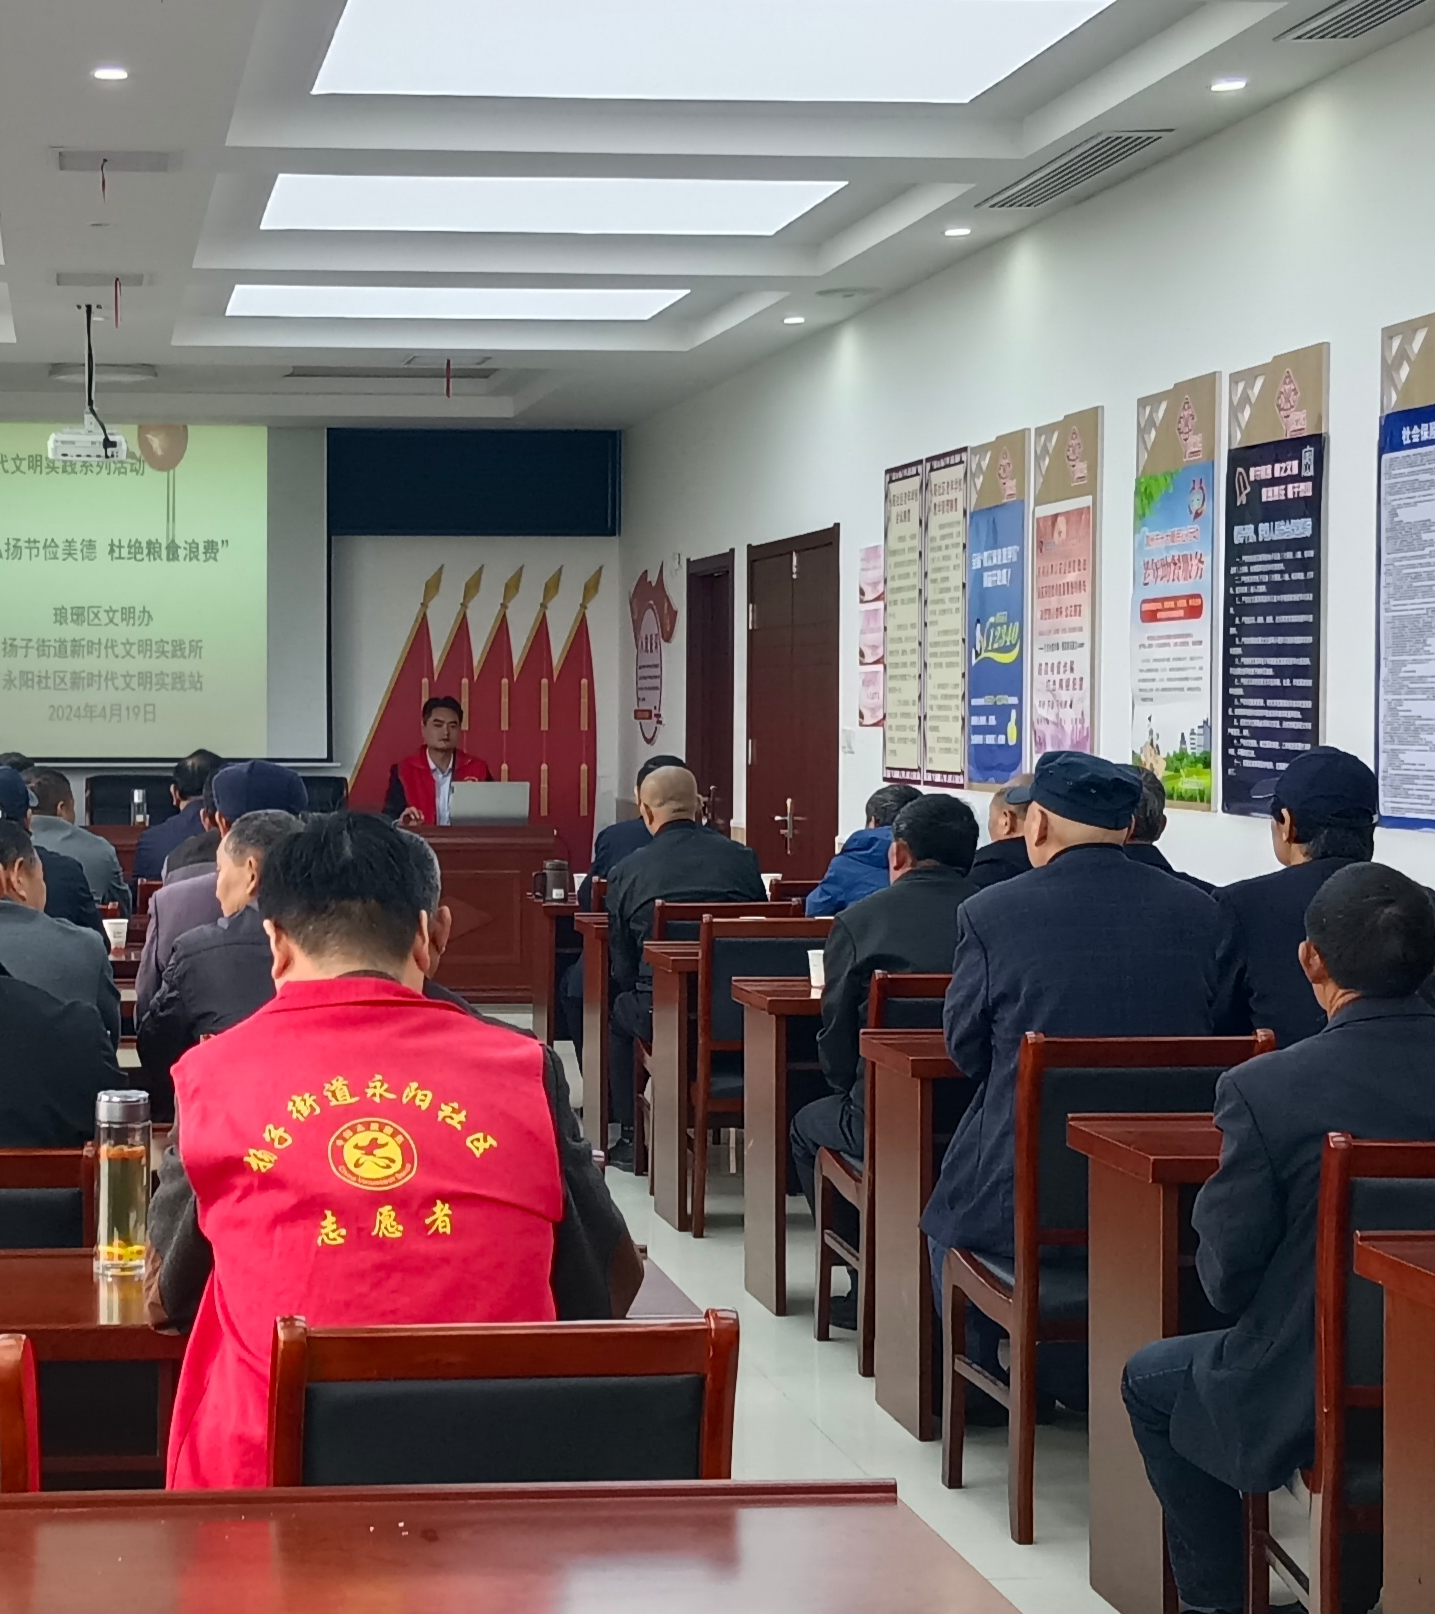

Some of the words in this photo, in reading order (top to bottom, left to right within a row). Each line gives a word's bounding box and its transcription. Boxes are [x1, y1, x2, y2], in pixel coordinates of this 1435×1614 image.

[107, 537, 230, 562] 杜绝粮食浪费”
[53, 605, 154, 627] 琅琊区文明办
[987, 621, 1020, 650] 12340
[2, 638, 204, 660] 扬子街道新时代文明实践所
[2, 670, 204, 692] 永阳社区新时代文明实践站
[48, 703, 157, 724] 2024年4月19日
[243, 1074, 498, 1173] 扬子街道永阳社区
[317, 1199, 453, 1247] 志愿者
